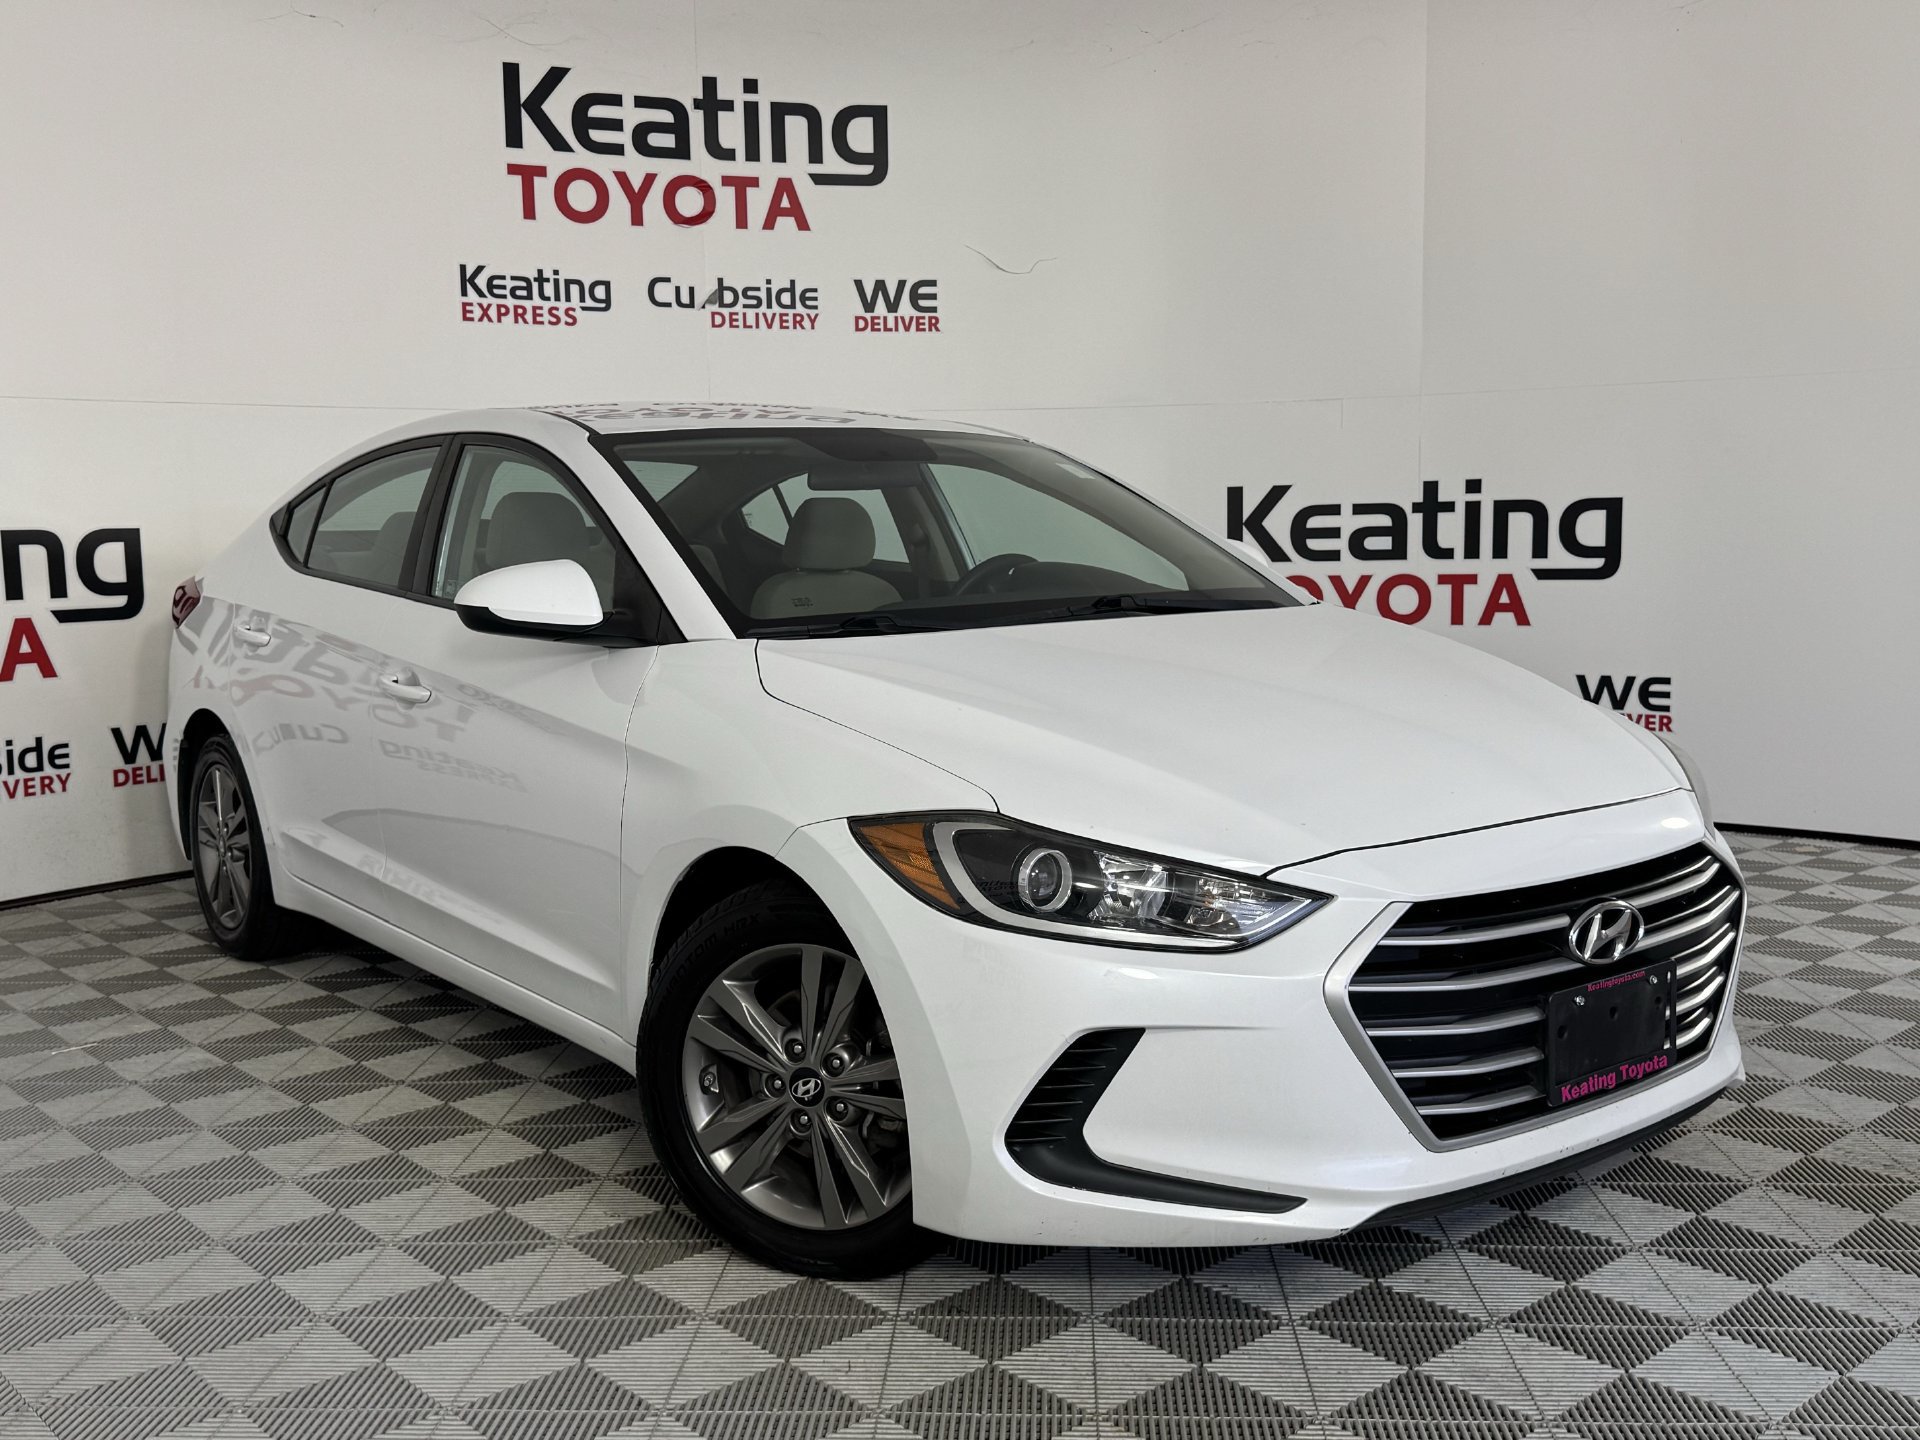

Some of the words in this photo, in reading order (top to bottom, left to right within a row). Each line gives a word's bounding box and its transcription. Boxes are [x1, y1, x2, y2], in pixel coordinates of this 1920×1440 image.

[502, 62, 888, 186] Keating
[506, 163, 811, 231] TOYOTA
[459, 264, 612, 311] Keating
[648, 276, 819, 310] Cubside
[853, 279, 938, 314] WE
[461, 302, 578, 327] EXPRESS
[711, 311, 819, 330] DELIVERY
[854, 316, 941, 332] DELIVER
[1227, 479, 1623, 581] Keating
[1575, 674, 1672, 712] WE
[1618, 712, 1673, 733] VER
[0, 736, 71, 776] ide
[1561, 1072, 1616, 1102] Keating
[1619, 1055, 1668, 1080] Toyota
